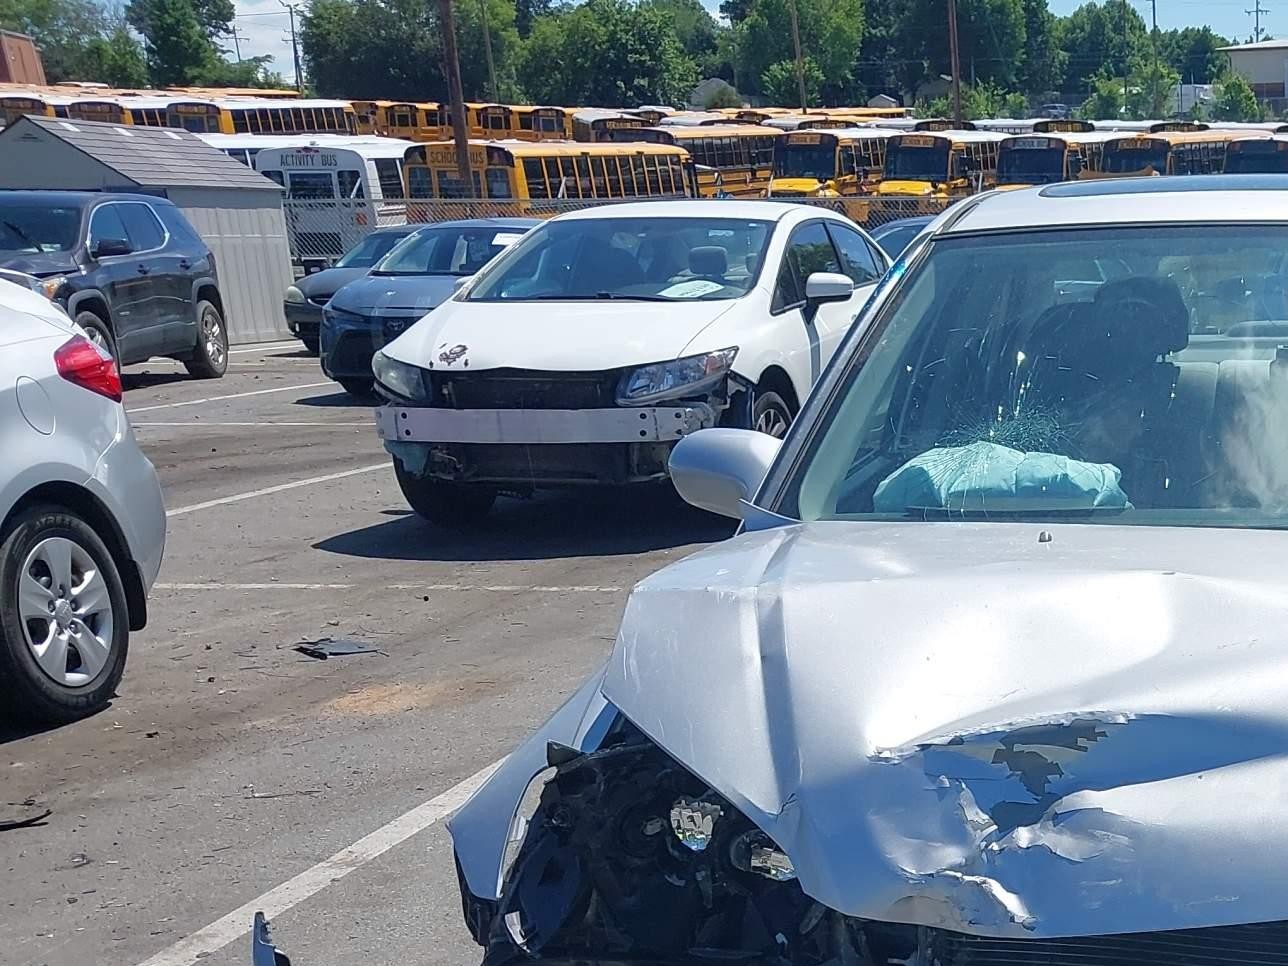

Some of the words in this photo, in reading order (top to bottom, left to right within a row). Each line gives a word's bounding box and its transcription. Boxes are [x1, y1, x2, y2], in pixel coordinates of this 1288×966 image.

[280, 154, 315, 167] ACTIVITY
[321, 154, 338, 167] BUS
[430, 151, 458, 164] SCHOO
[470, 151, 485, 164] US
